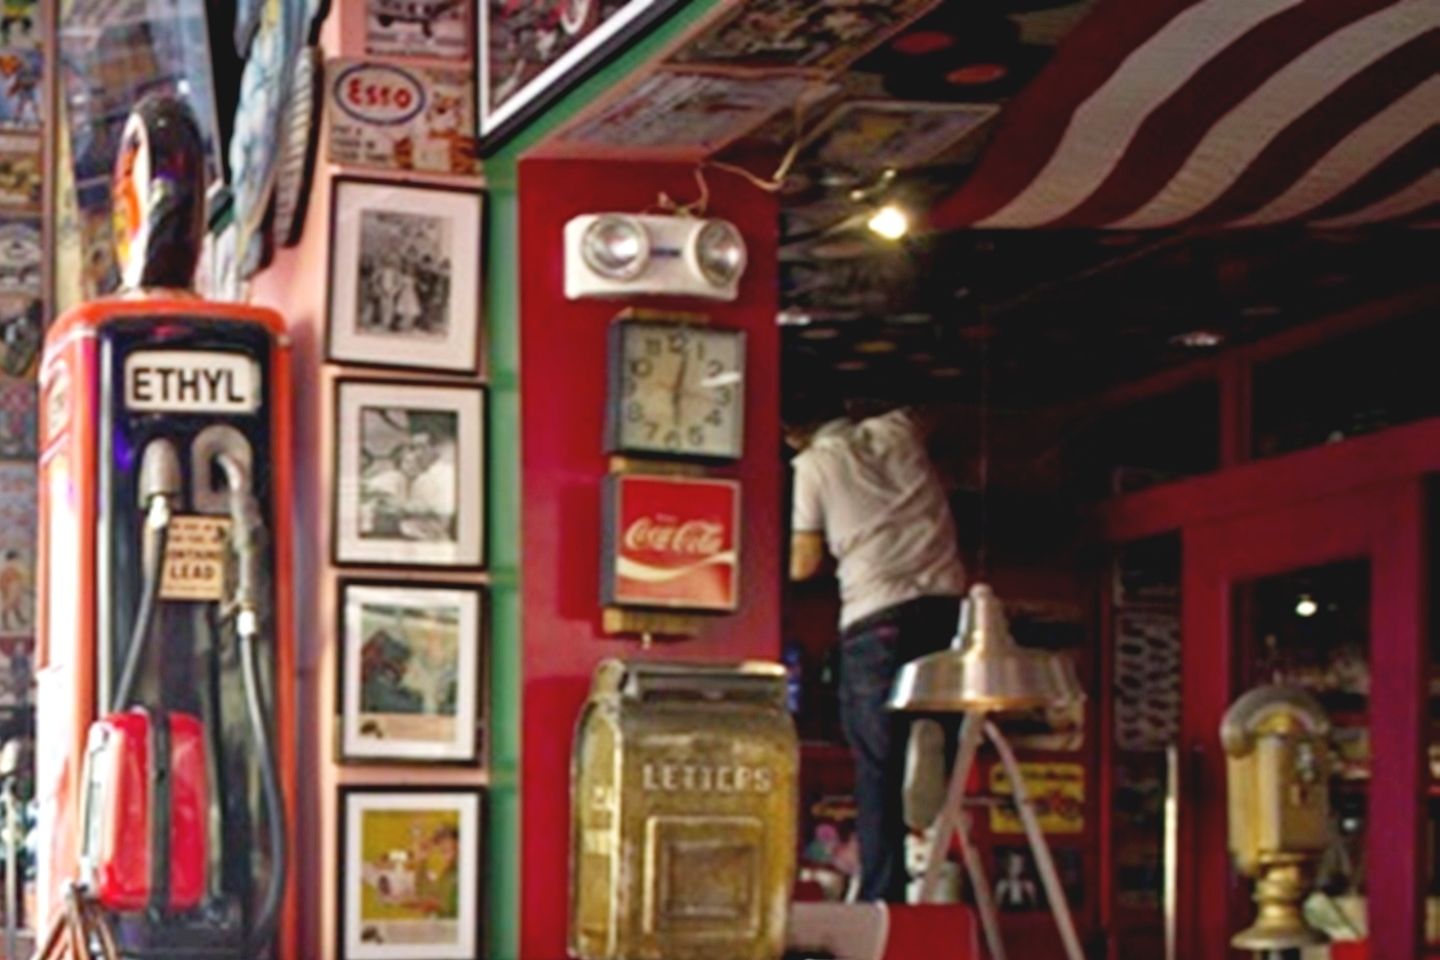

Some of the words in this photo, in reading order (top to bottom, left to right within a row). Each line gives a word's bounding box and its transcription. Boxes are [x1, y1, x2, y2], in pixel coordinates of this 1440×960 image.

[347, 77, 412, 110] Esso
[132, 366, 245, 403] ETHYL
[169, 564, 217, 580] LEAD
[642, 763, 773, 793] LETTERS
